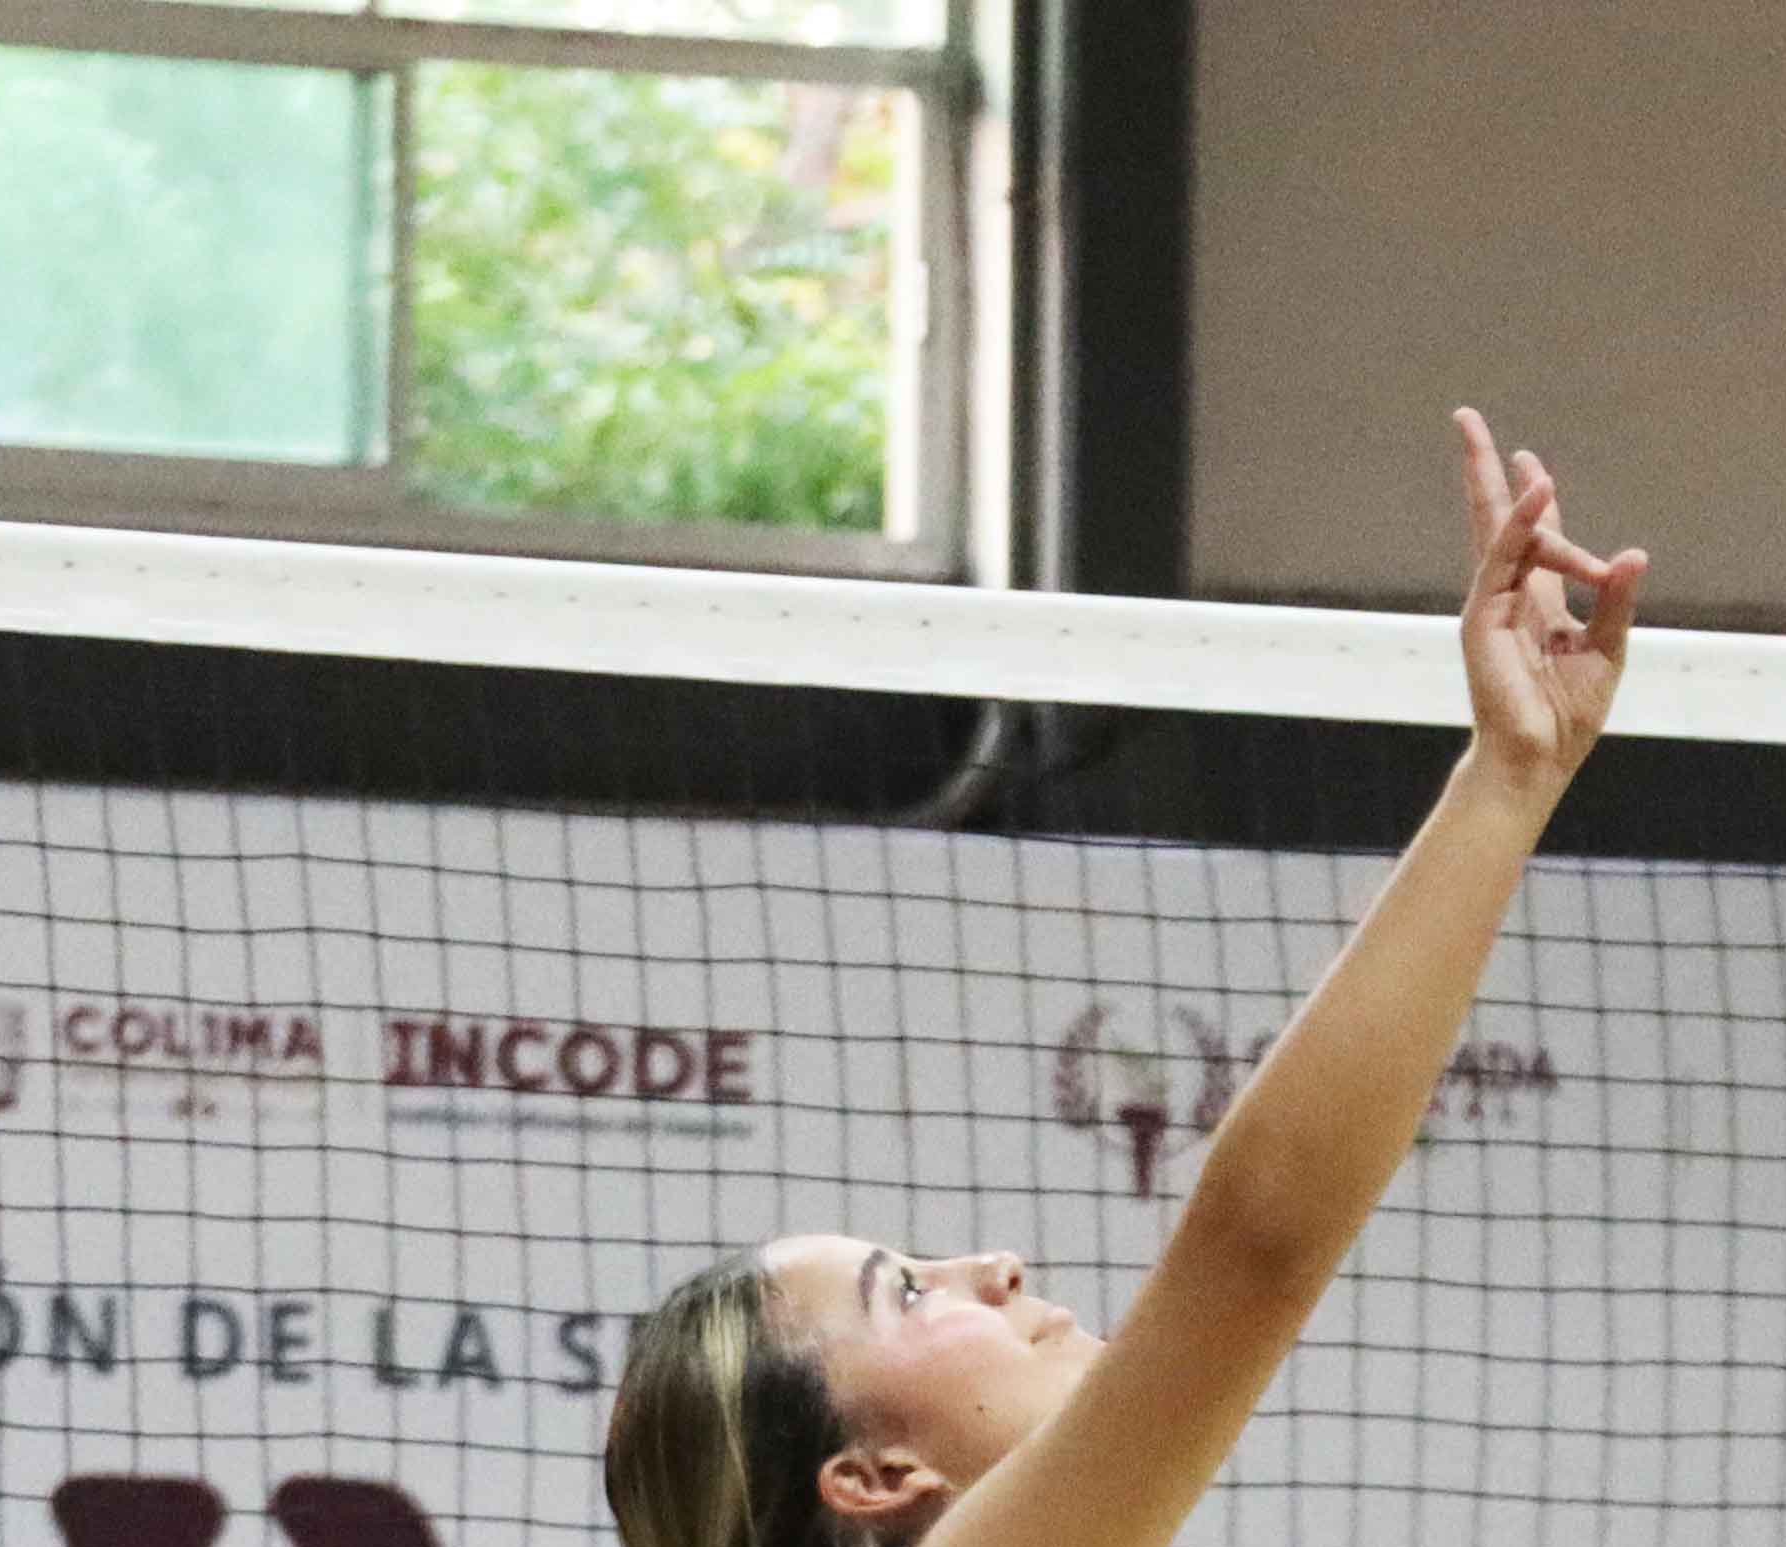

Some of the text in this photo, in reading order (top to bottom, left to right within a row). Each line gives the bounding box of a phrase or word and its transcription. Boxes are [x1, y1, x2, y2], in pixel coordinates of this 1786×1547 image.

[62, 1006, 325, 1061] COLIMA
[383, 1018, 754, 1101] INCODE
[183, 1298, 319, 1383] DE
[374, 1305, 502, 1388] LA
